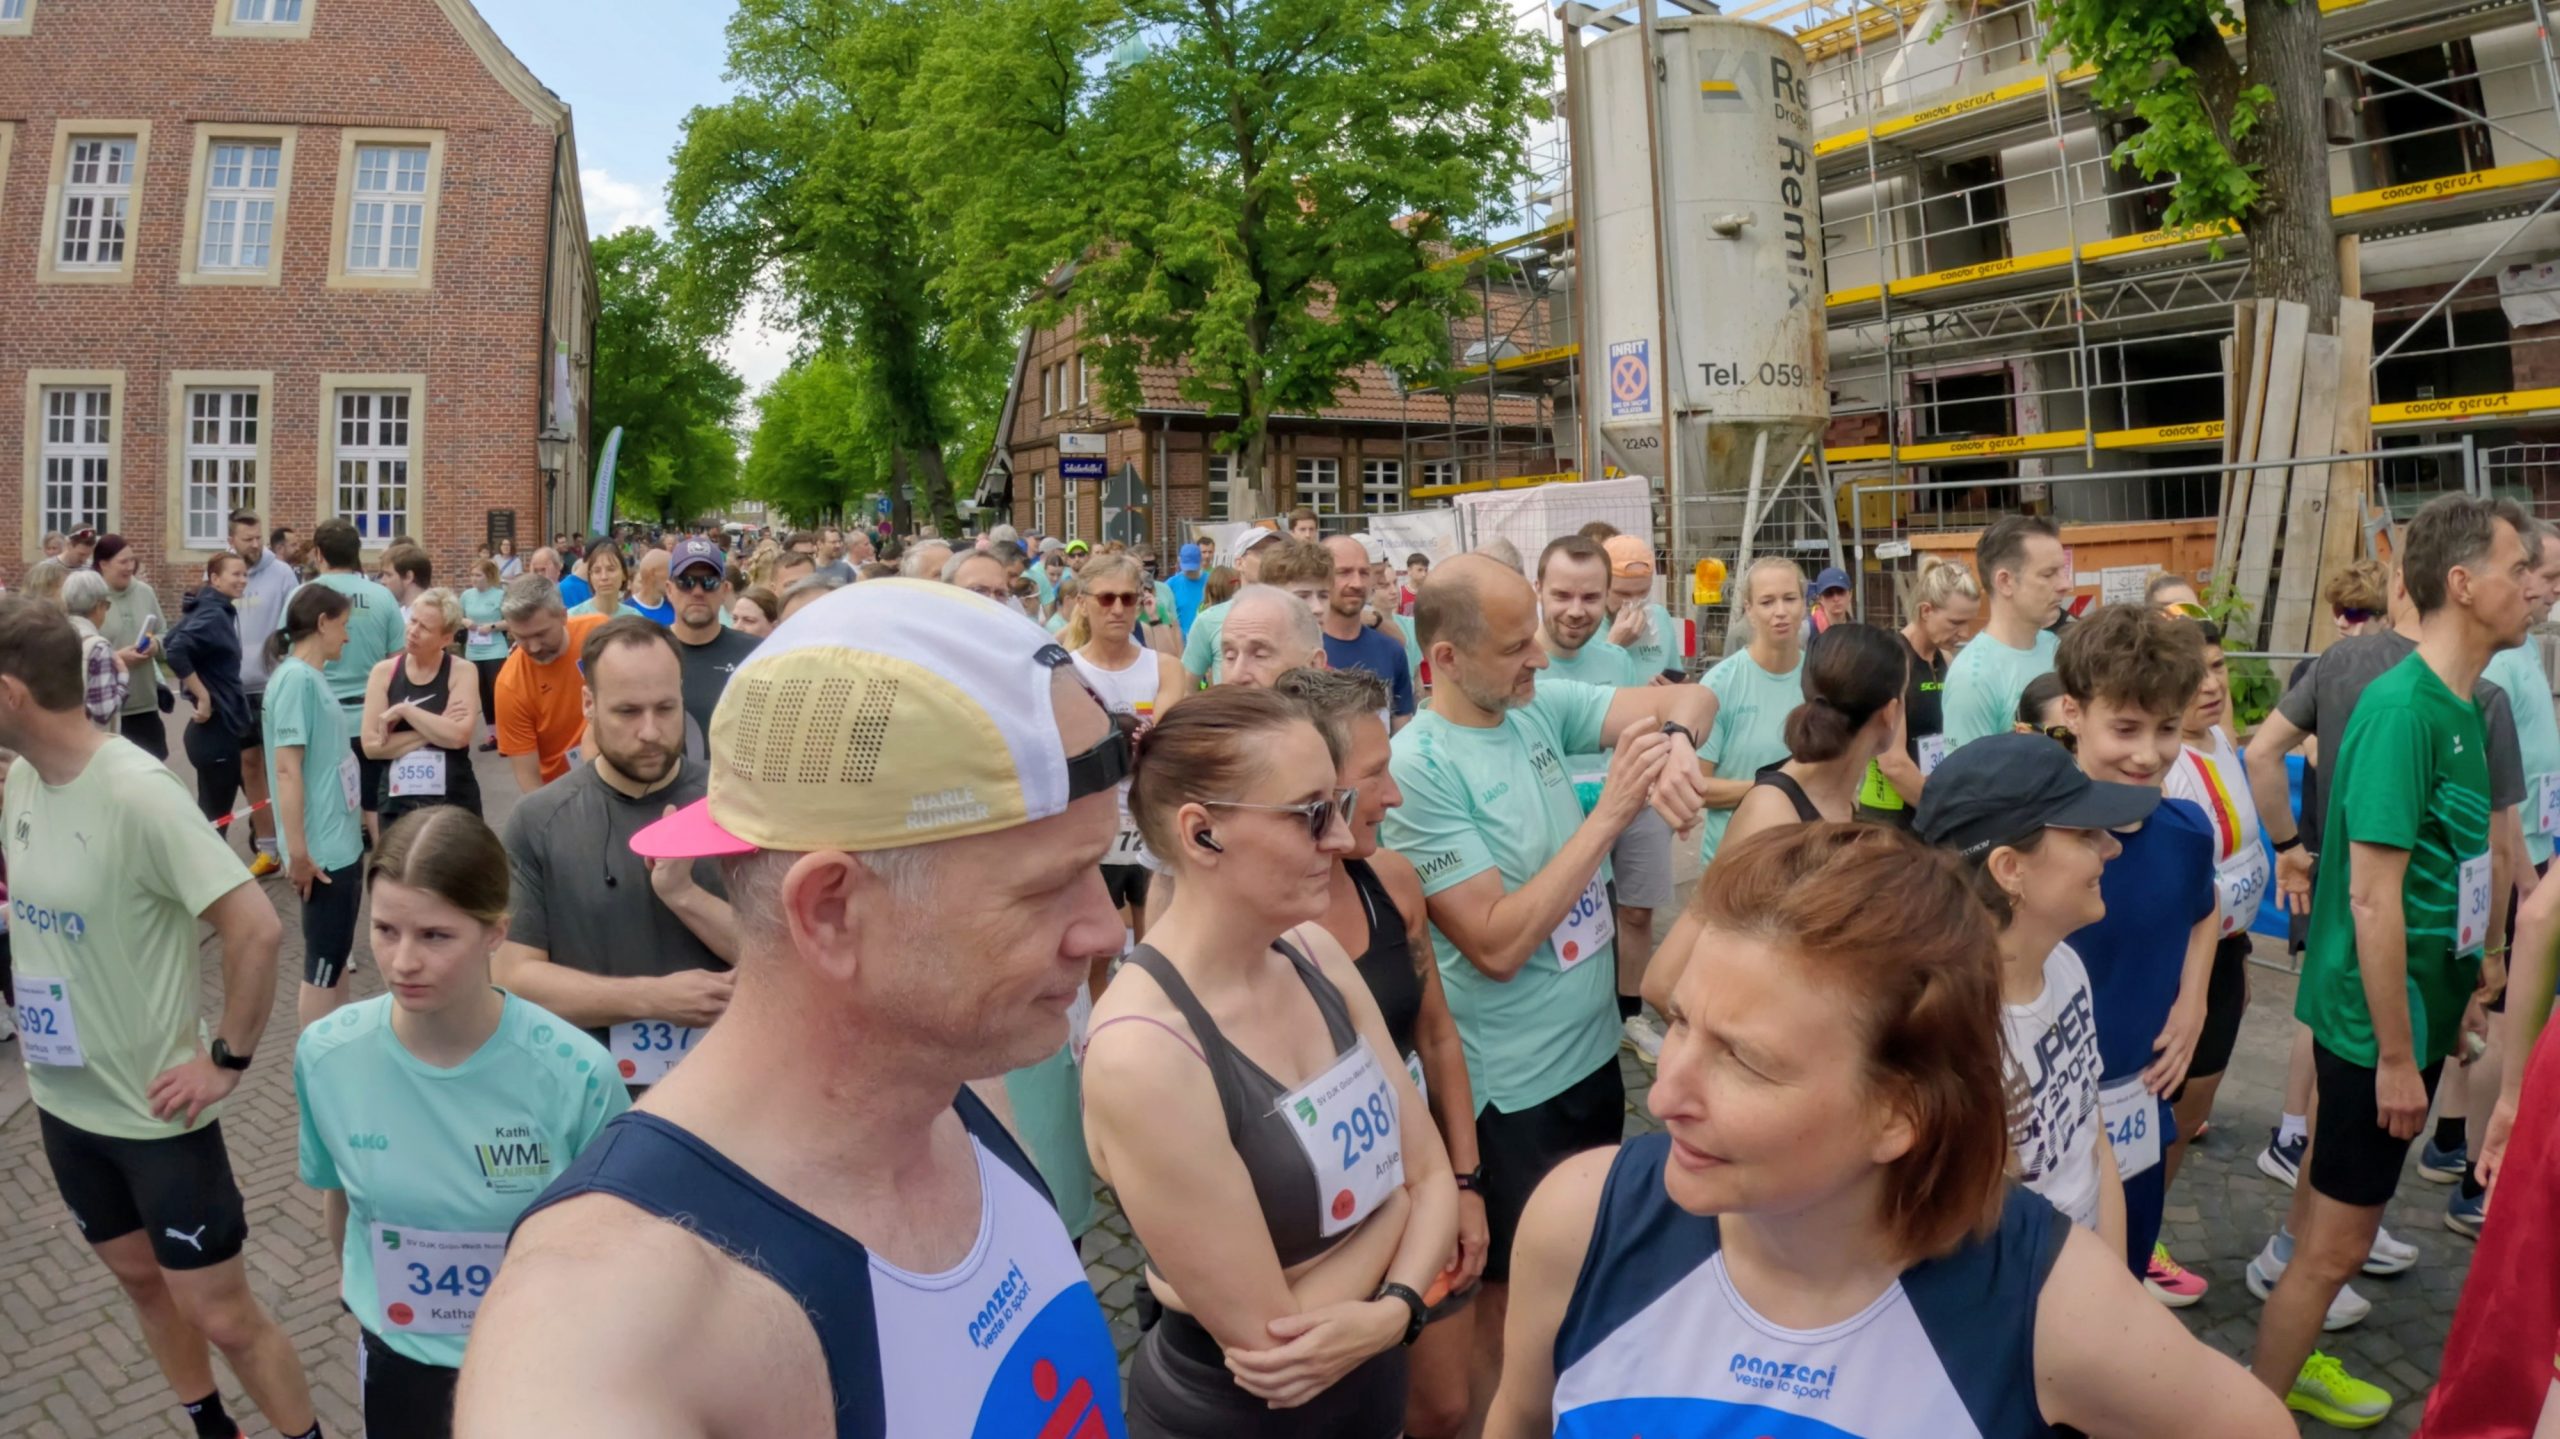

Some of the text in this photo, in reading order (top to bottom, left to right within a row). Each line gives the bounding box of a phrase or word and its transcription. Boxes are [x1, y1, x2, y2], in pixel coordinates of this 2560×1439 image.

[2382, 183, 2428, 200] condor
[1777, 135, 1813, 309] Remix
[1940, 267, 1975, 281] condor
[1612, 340, 1645, 357] INRIT
[1698, 362, 1746, 386] Tel.
[2404, 401, 2454, 414] condor
[1623, 437, 1658, 449] 2240
[1950, 440, 1984, 451] condor
[398, 765, 435, 780] 3556
[905, 803, 991, 830] RUNNER
[2231, 866, 2264, 907] 2953
[495, 1126, 530, 1138] Kathi
[1374, 1151, 1400, 1180] Anke
[968, 1258, 1024, 1348] panzeri
[981, 1317, 1005, 1350] veste
[1011, 1280, 1031, 1312] sport
[1728, 1353, 1837, 1387] panzeri
[1735, 1372, 1831, 1400] veste lo sport
